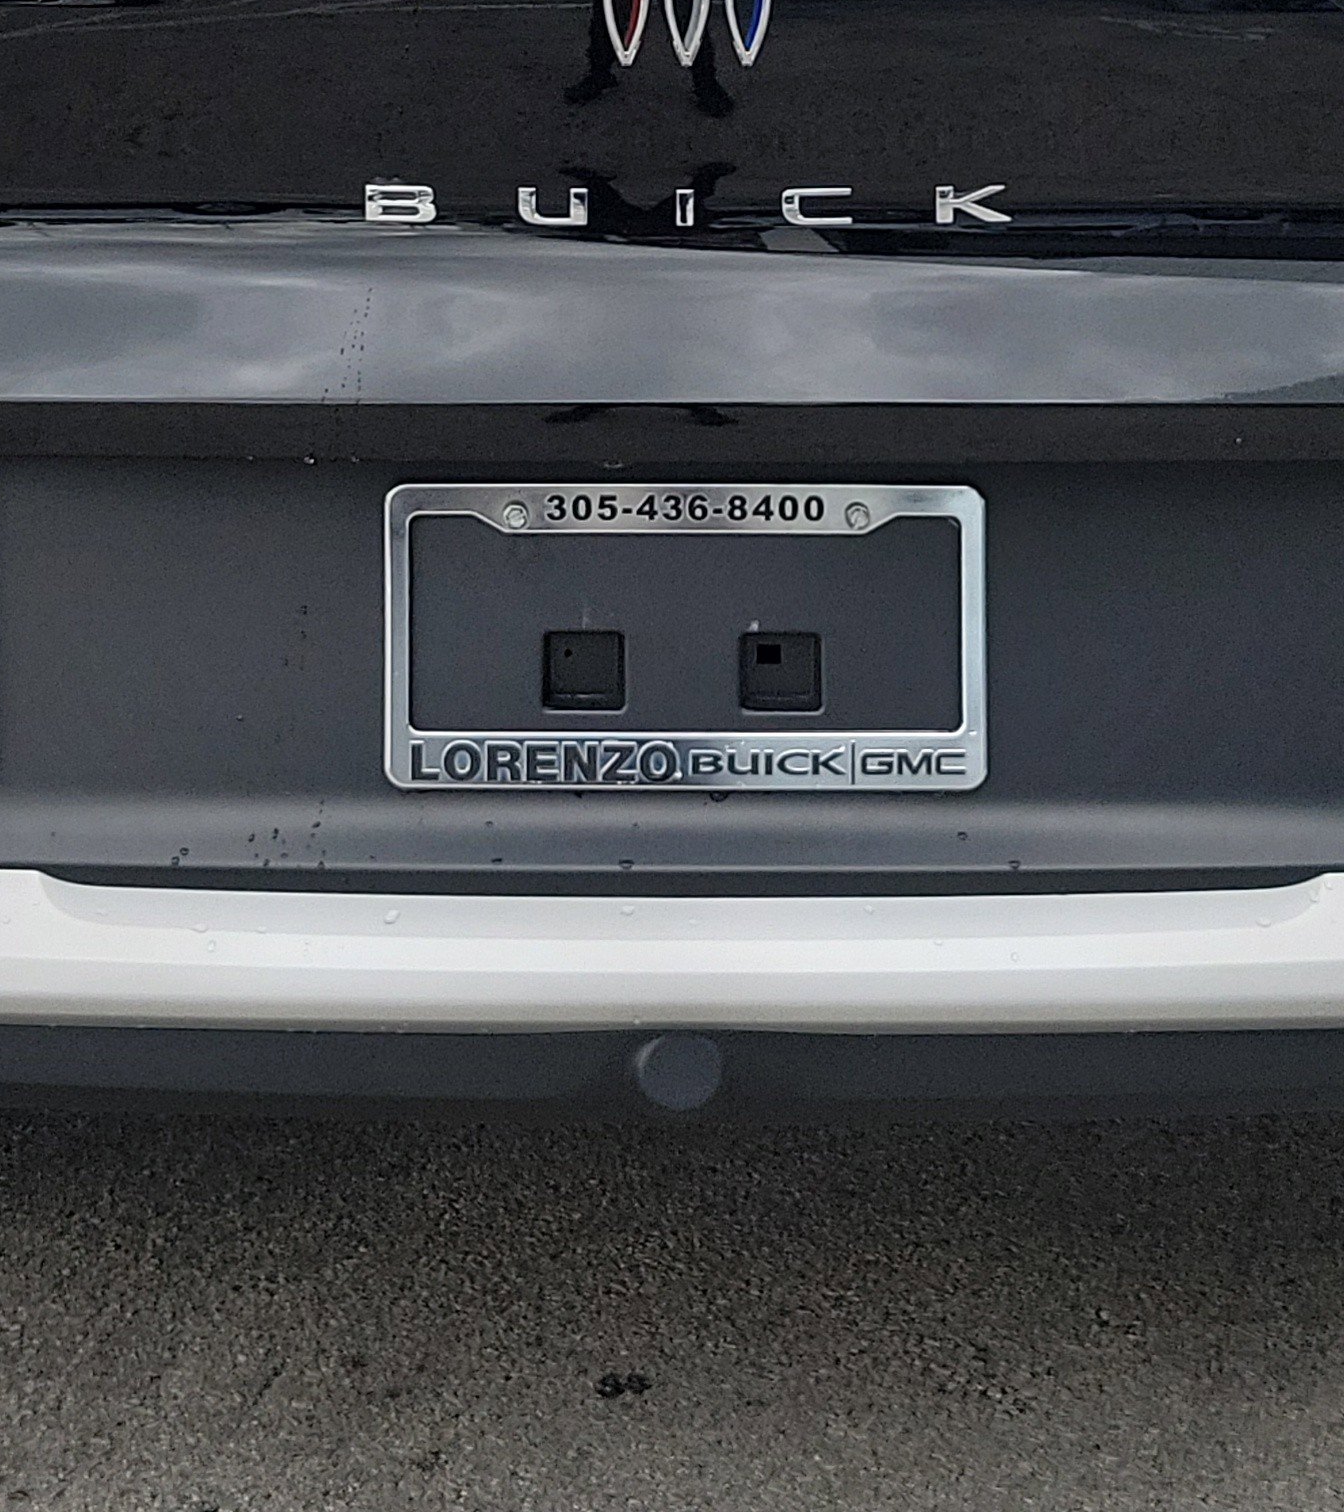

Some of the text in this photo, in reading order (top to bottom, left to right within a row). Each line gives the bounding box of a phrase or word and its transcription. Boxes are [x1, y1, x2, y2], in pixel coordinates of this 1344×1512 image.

[364, 184, 1012, 225] BUICK
[545, 494, 825, 522] 305-436-8400
[410, 740, 967, 782] LORENZO BUICK GMC
